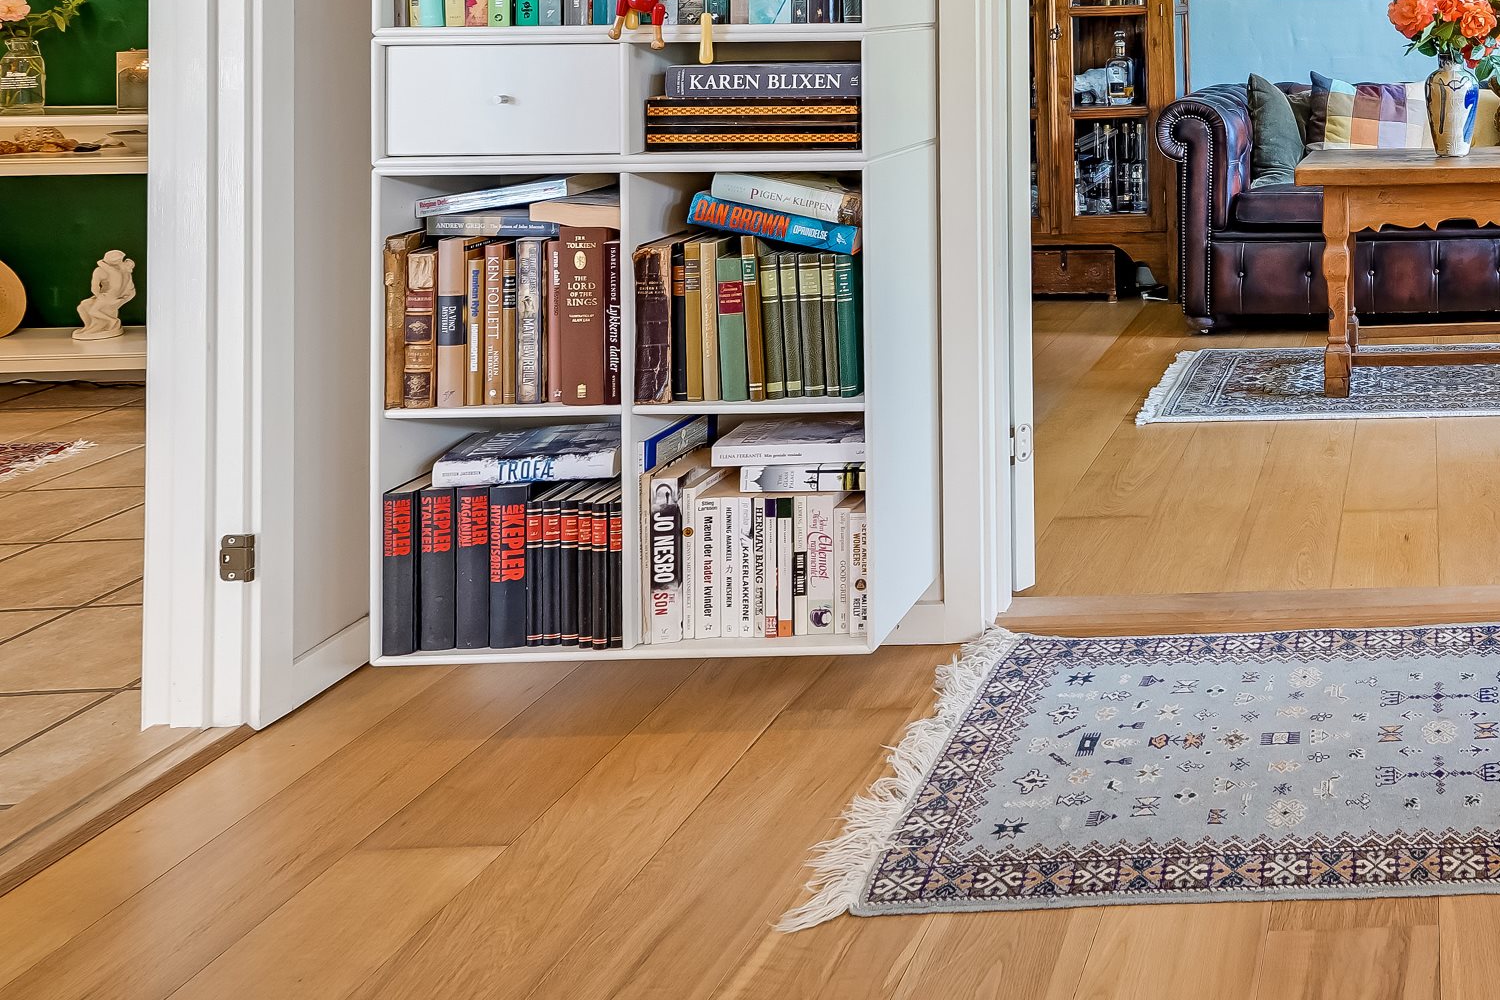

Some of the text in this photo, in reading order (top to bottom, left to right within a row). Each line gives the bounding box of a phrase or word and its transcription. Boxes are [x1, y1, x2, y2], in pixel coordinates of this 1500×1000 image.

[523, 2, 532, 19] øje
[689, 74, 841, 90] KAREN BLIXEN
[694, 200, 790, 238] DAN BROWN
[488, 257, 499, 339] KEN FOLLETT
[566, 298, 597, 306] RINGS
[608, 304, 619, 343] Lykkens
[610, 345, 620, 372] datter
[393, 507, 410, 556] KEPLER
[422, 497, 431, 552] STALKER
[434, 504, 450, 552] KEPLER
[491, 505, 500, 582] HYPNOTISØREN
[654, 512, 674, 532] JO
[501, 514, 524, 582] KEPLER
[704, 516, 713, 617] Mænd der hader kvinder
[755, 507, 763, 583] HERMAN BANG
[655, 593, 668, 615] SON
